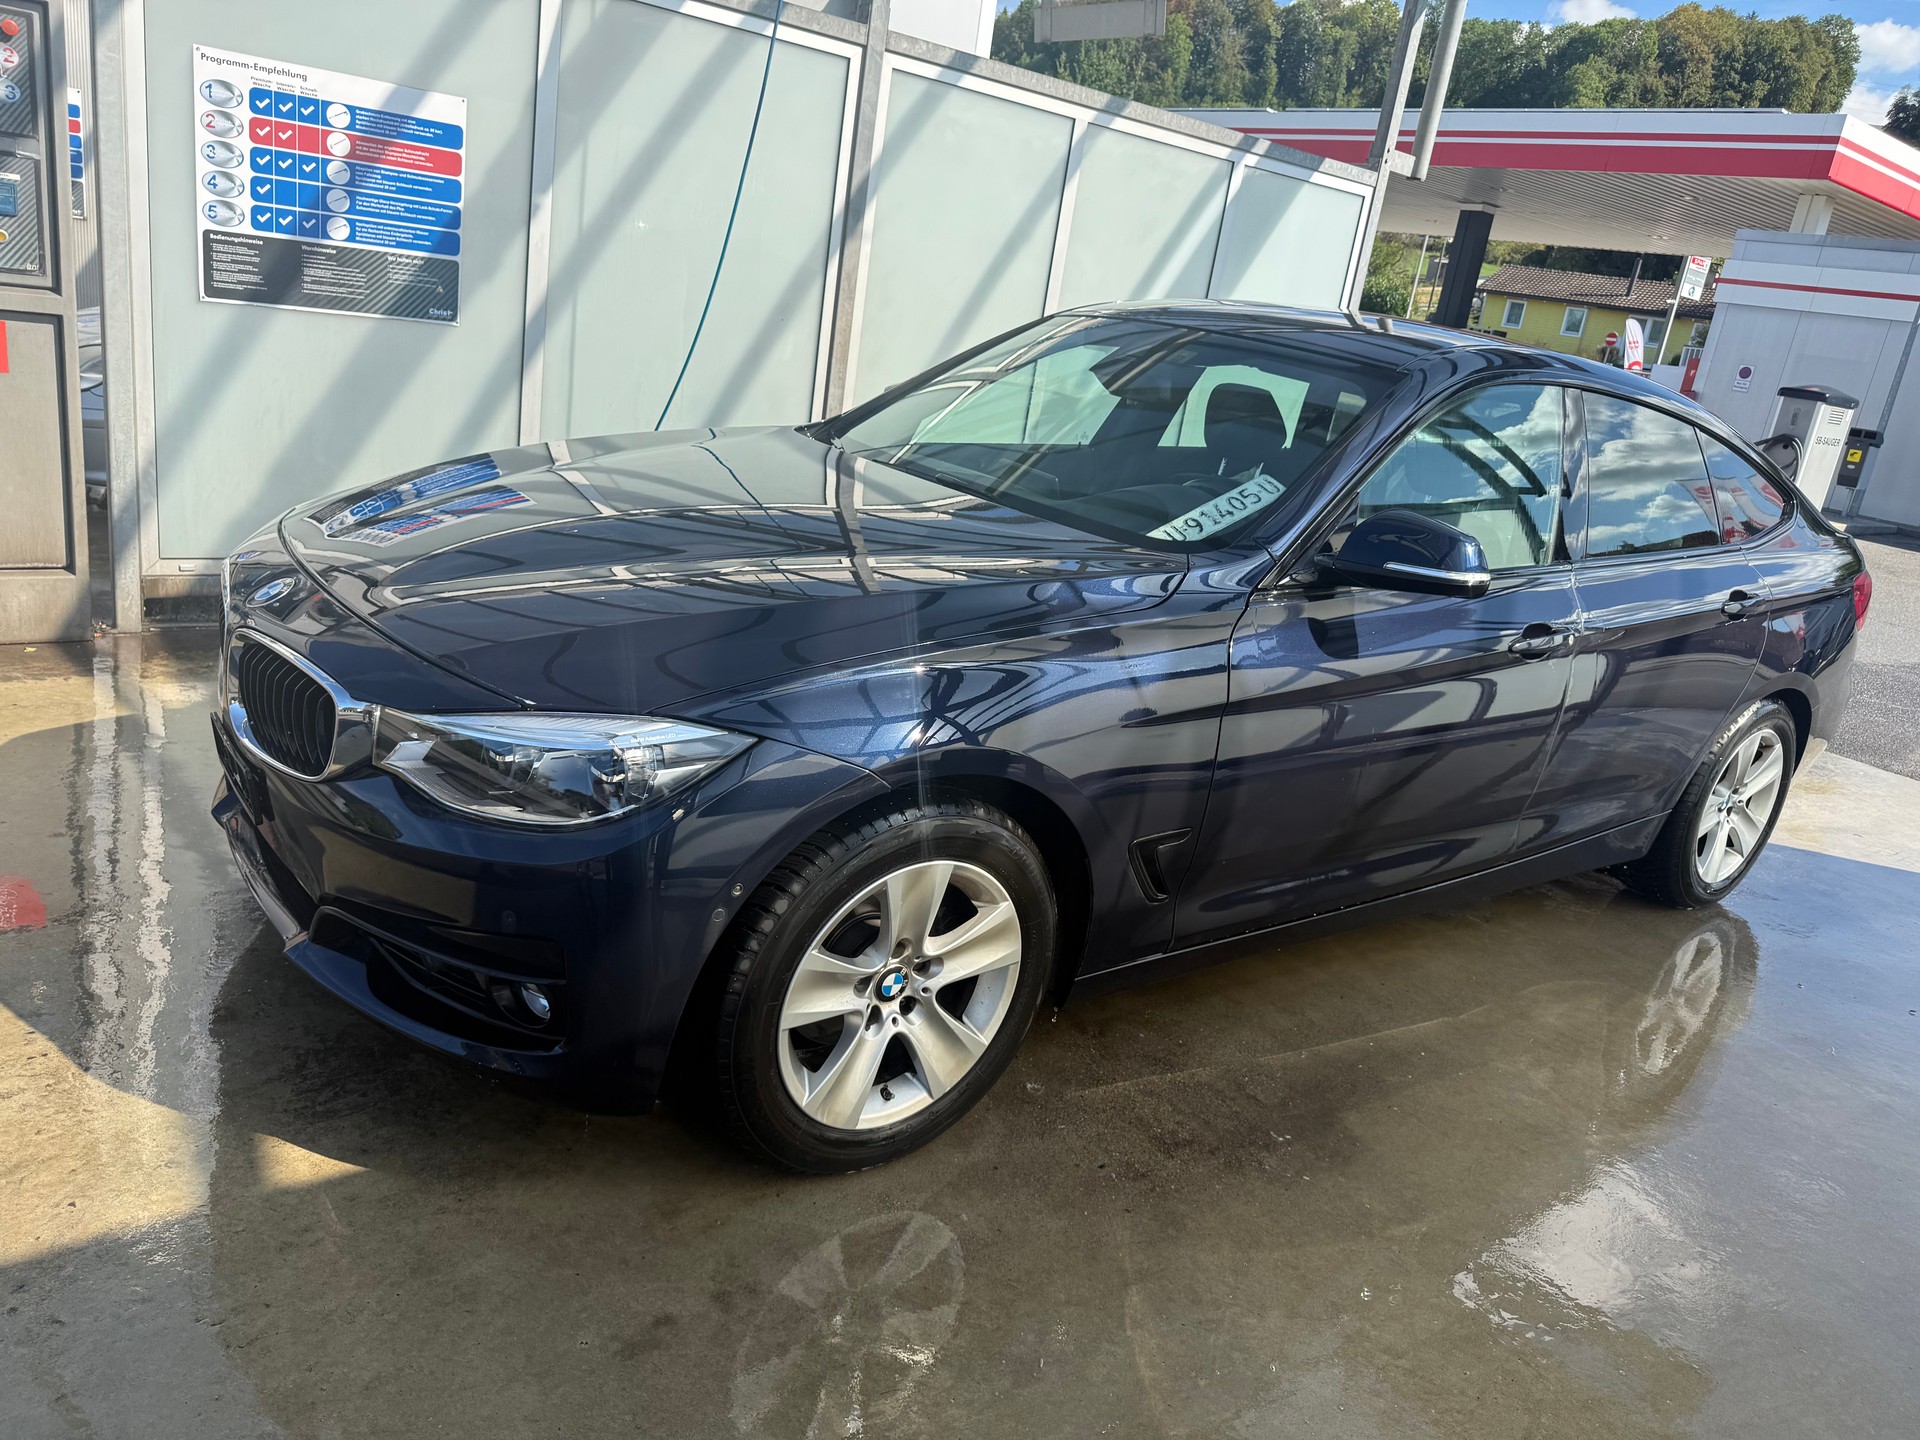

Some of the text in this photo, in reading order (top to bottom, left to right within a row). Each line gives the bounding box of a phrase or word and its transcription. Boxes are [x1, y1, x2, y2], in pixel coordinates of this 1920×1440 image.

[201, 52, 308, 82] Programm-Empfehlung
[205, 83, 212, 98] 1
[205, 113, 216, 128] 2
[206, 144, 216, 159] 3
[207, 174, 218, 189] 4
[207, 205, 217, 219] 5
[210, 233, 264, 245] Bedienungshinweise
[301, 244, 336, 255] Warnhinweise
[429, 307, 453, 316] Christ
[1815, 435, 1841, 447] SB-SAUGER
